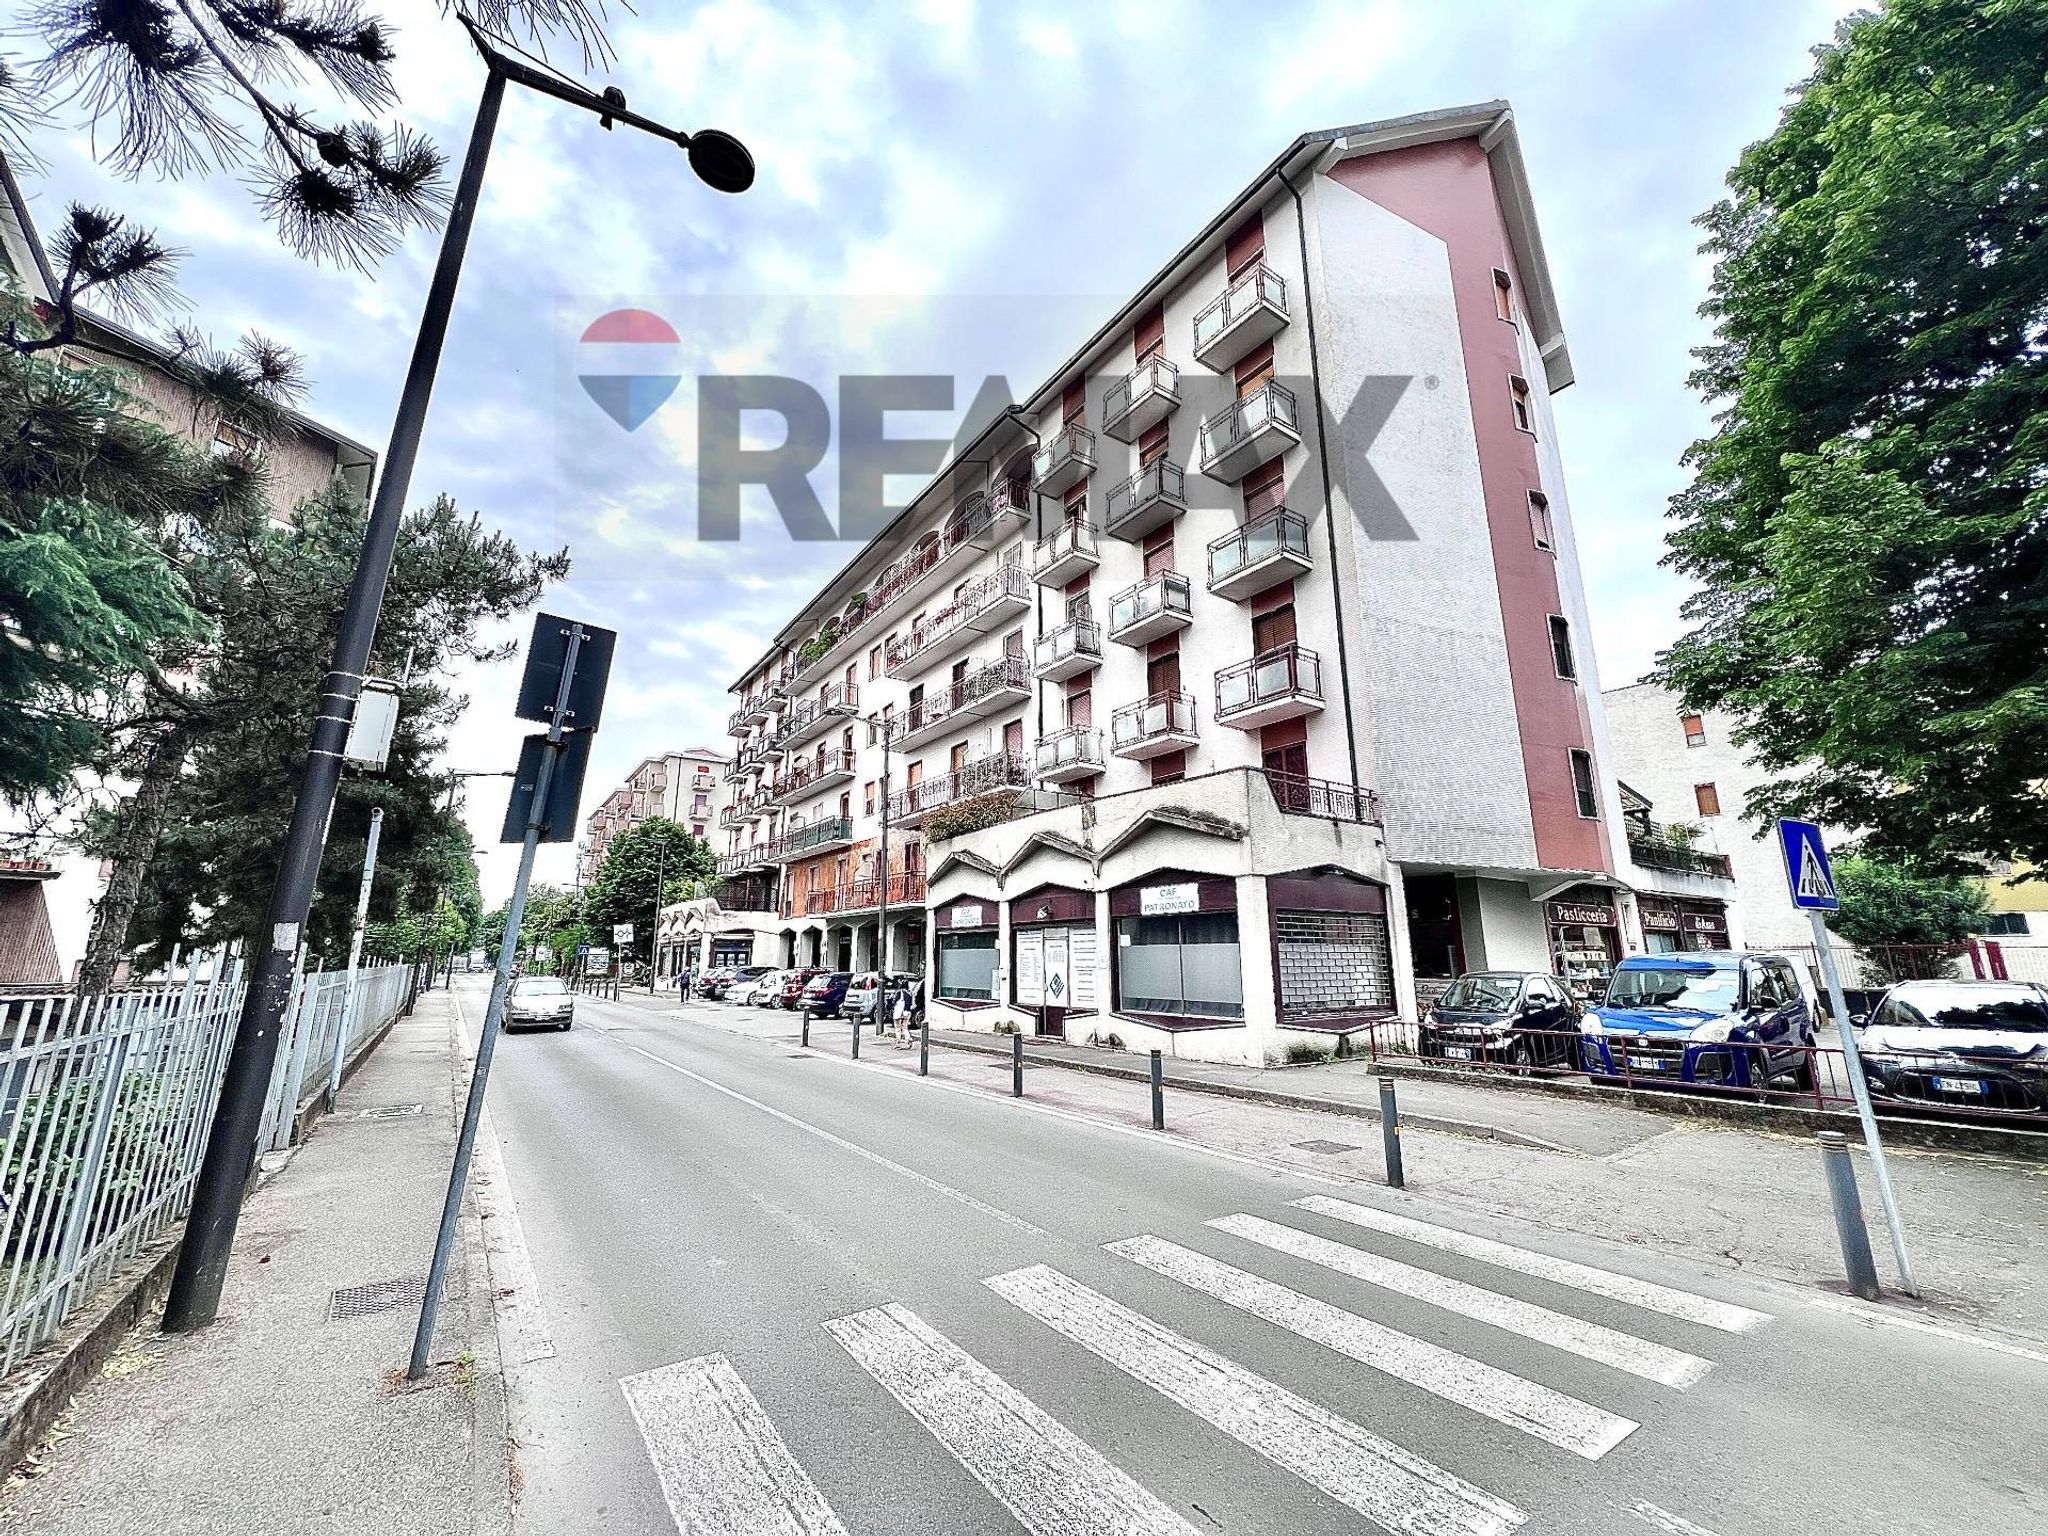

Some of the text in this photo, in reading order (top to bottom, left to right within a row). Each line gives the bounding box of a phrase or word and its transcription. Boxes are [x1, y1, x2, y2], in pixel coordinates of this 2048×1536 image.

[1160, 888, 1177, 897] CAF
[1144, 901, 1195, 912] PATRONATO
[1557, 906, 1608, 923] Pasticceria
